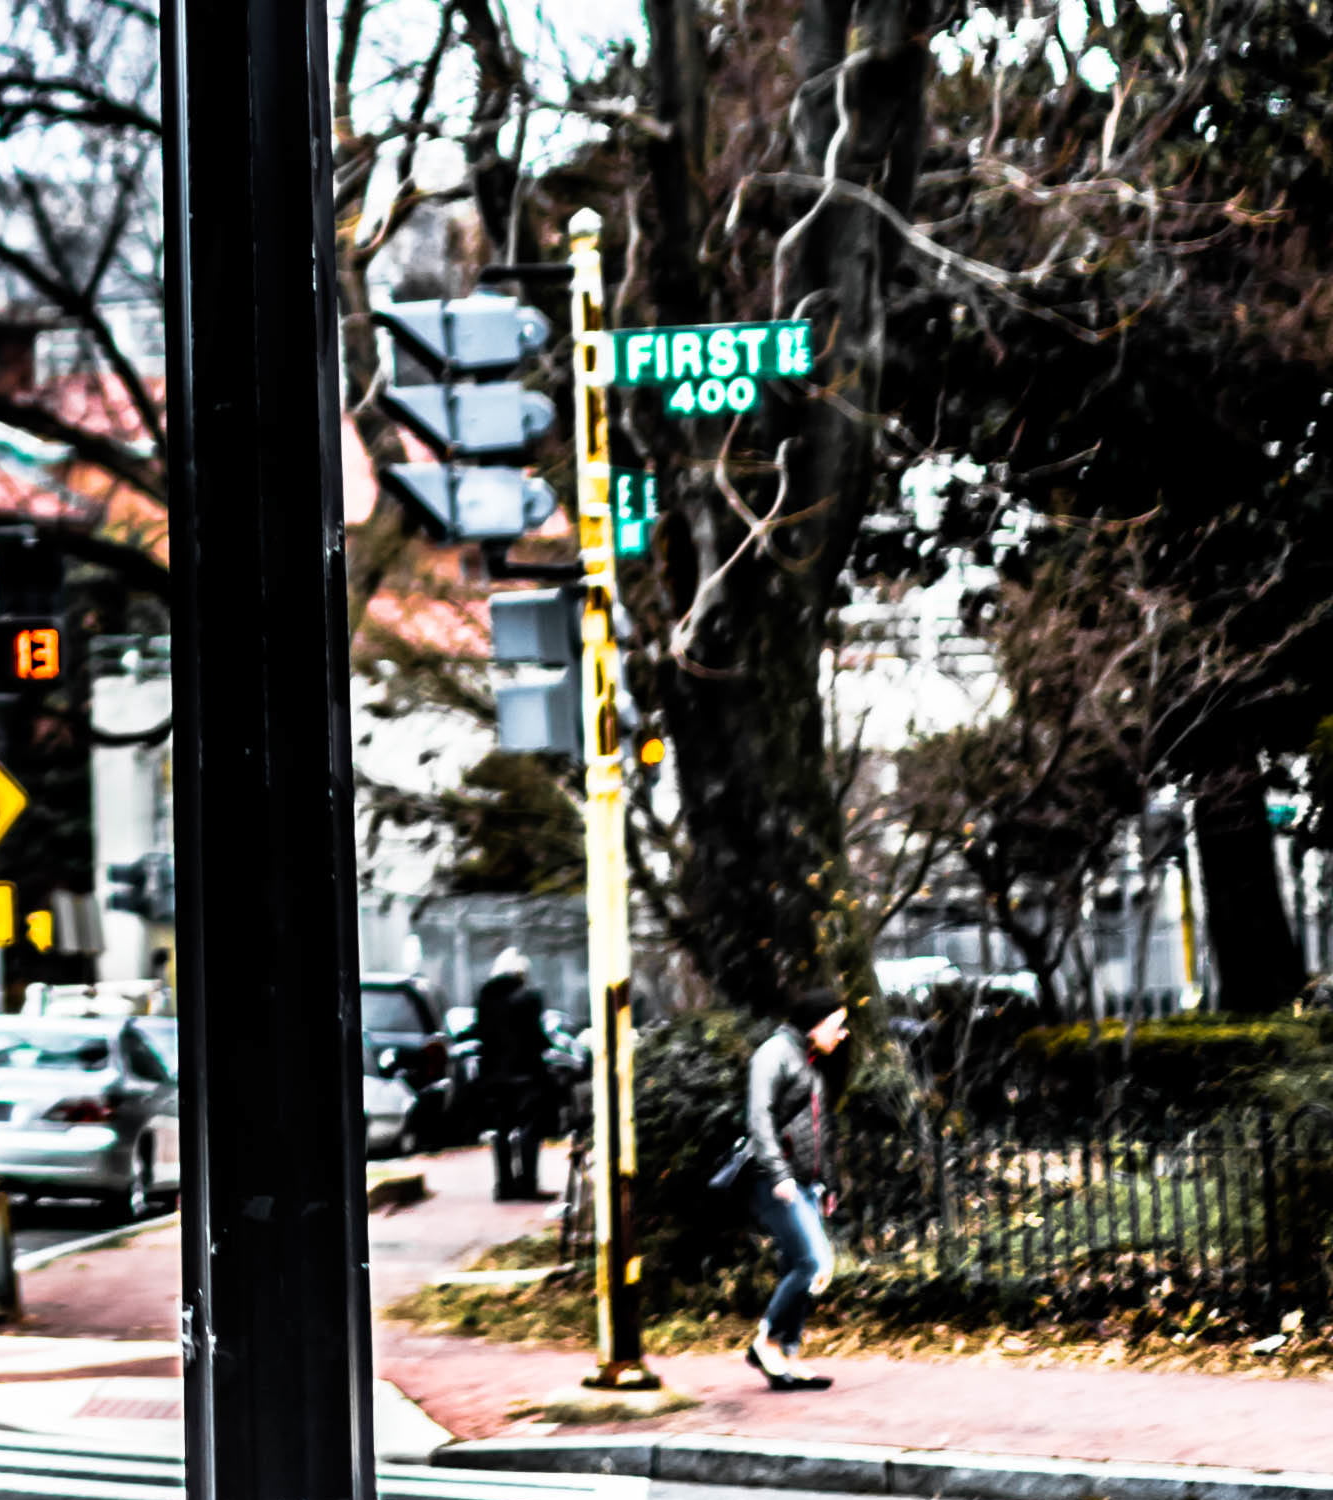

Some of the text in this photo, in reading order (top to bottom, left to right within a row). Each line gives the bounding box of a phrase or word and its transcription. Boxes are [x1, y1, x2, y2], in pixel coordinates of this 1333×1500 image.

[627, 329, 768, 380] FIRST
[669, 377, 756, 414] 400
[15, 628, 59, 679] 13
